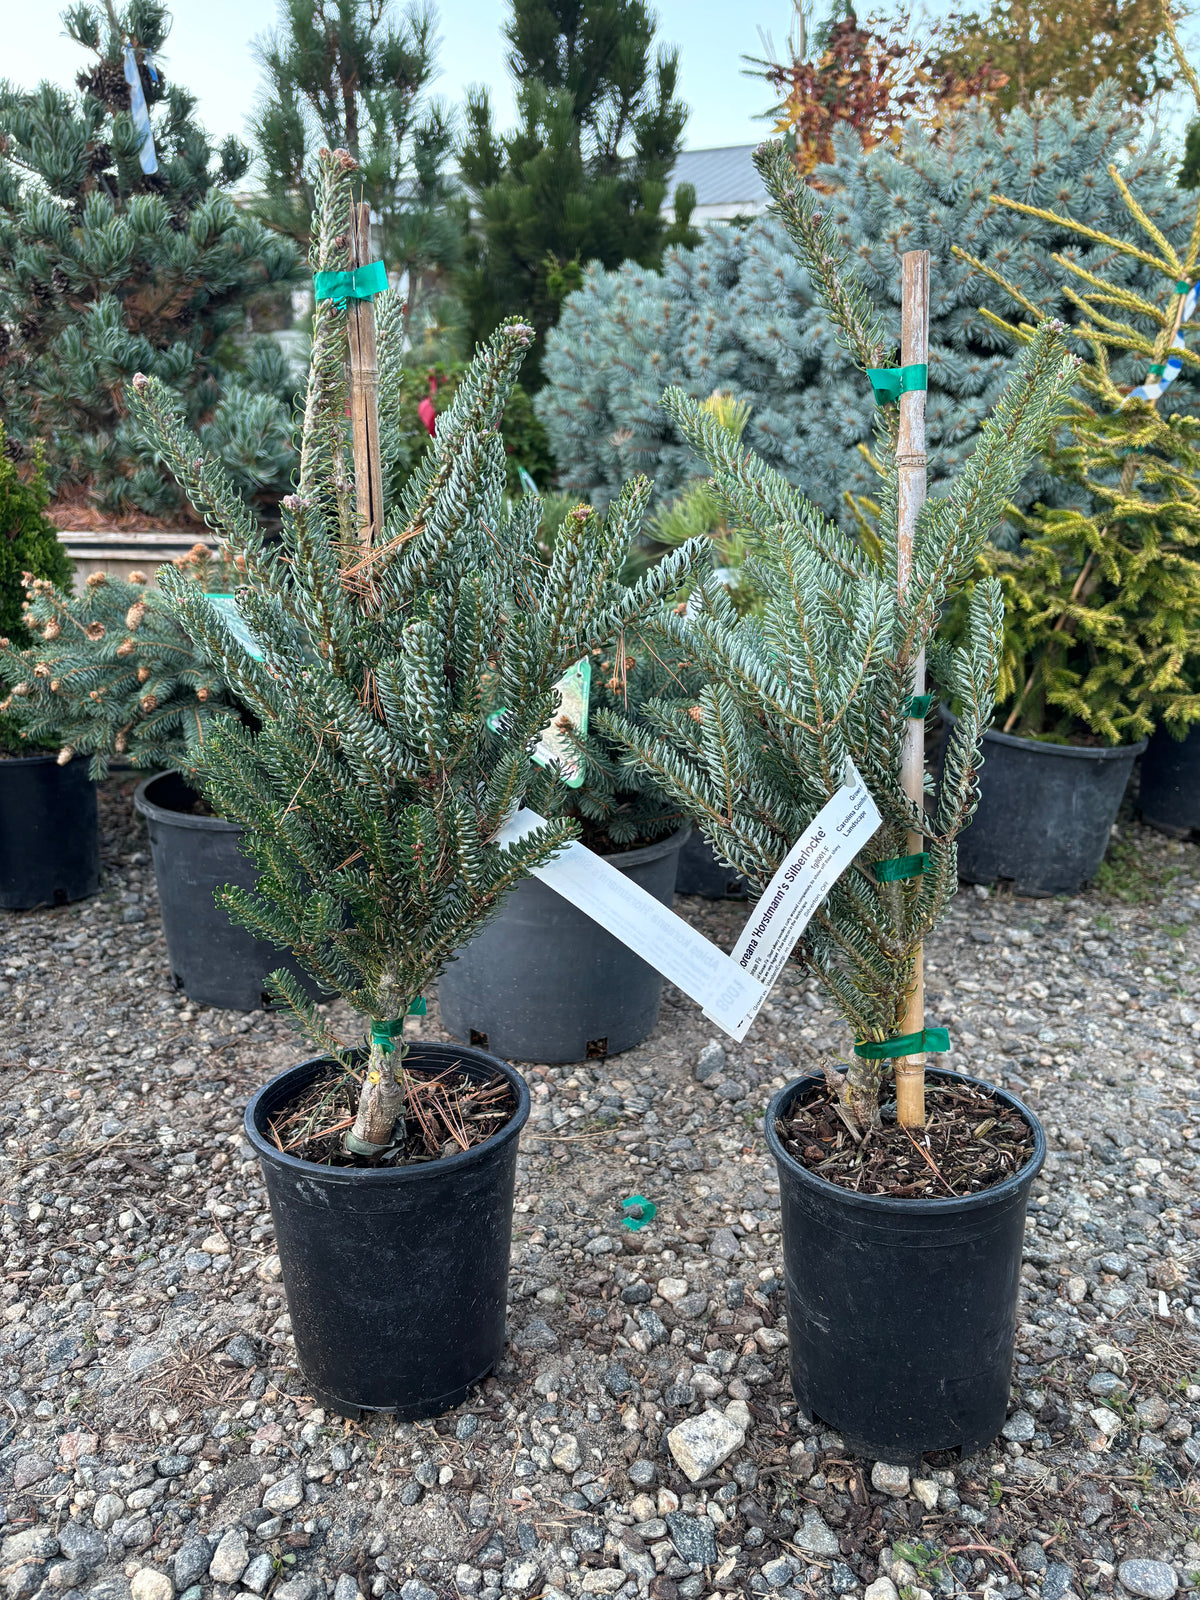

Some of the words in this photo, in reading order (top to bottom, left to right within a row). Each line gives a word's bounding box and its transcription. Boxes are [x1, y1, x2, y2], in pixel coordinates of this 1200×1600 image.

[835, 809, 856, 833] Carolina
[843, 810, 868, 838] Landscape
[738, 938, 759, 969] oreana
[751, 880, 790, 940] 'Horstmann's
[784, 825, 828, 883] Silberlocke'
